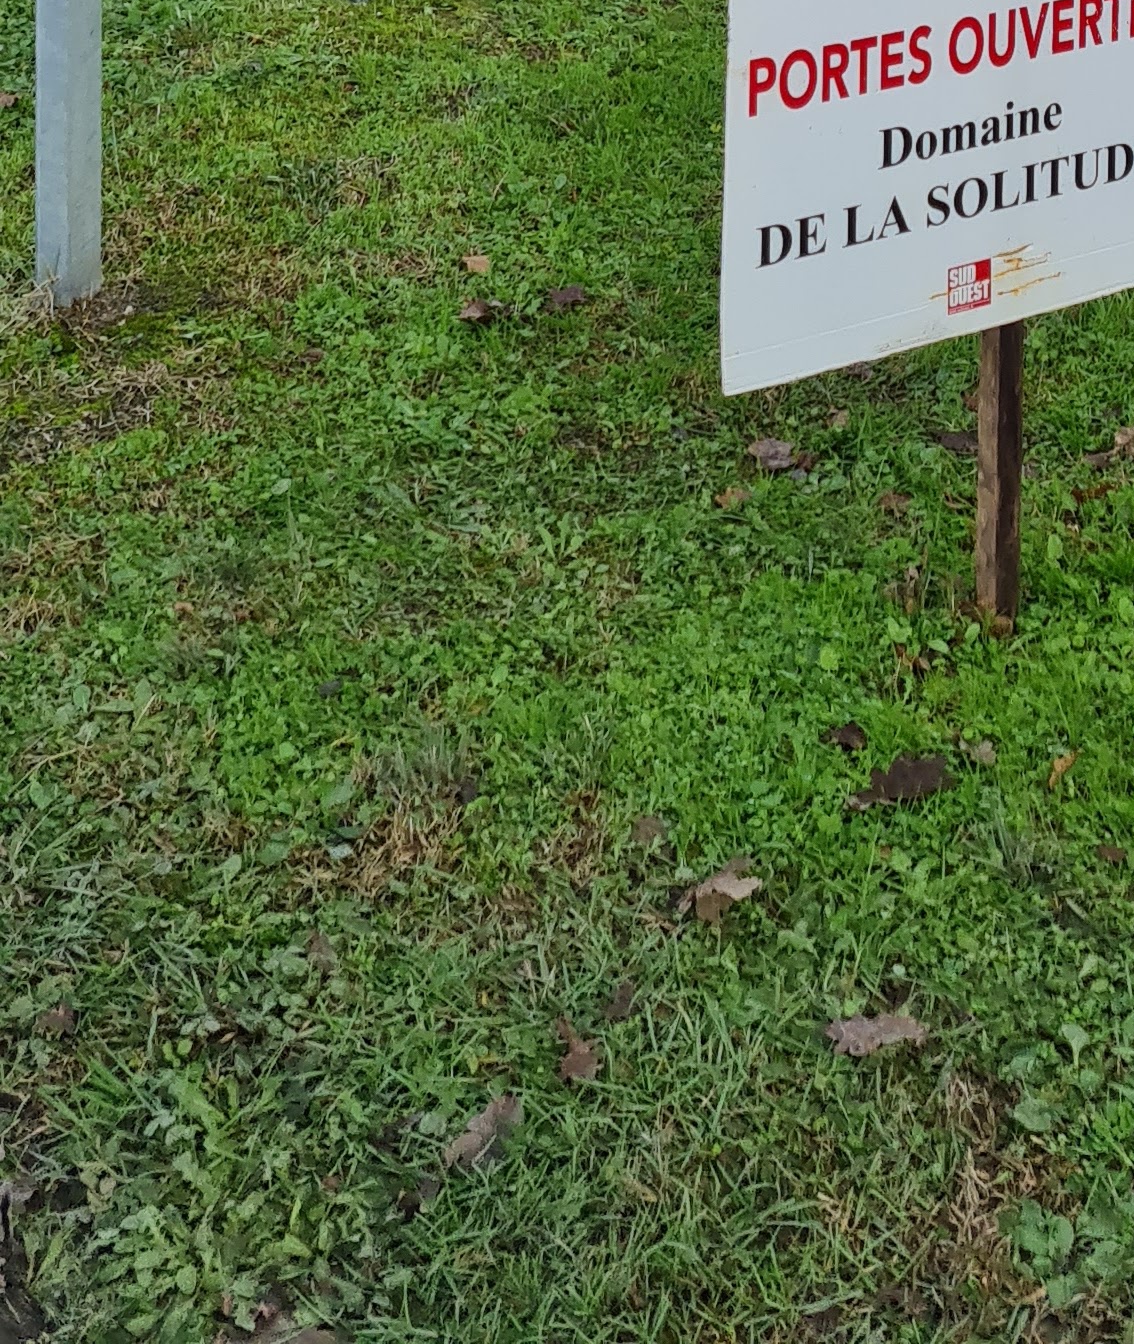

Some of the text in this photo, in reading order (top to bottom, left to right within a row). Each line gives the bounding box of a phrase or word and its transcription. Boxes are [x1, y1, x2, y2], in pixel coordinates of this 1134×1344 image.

[748, 24, 932, 118] PORTES
[877, 101, 1063, 170] Domaine
[755, 213, 828, 269] DE
[841, 196, 911, 248] LA
[949, 264, 977, 288] SUD
[949, 278, 990, 308] OUEST
